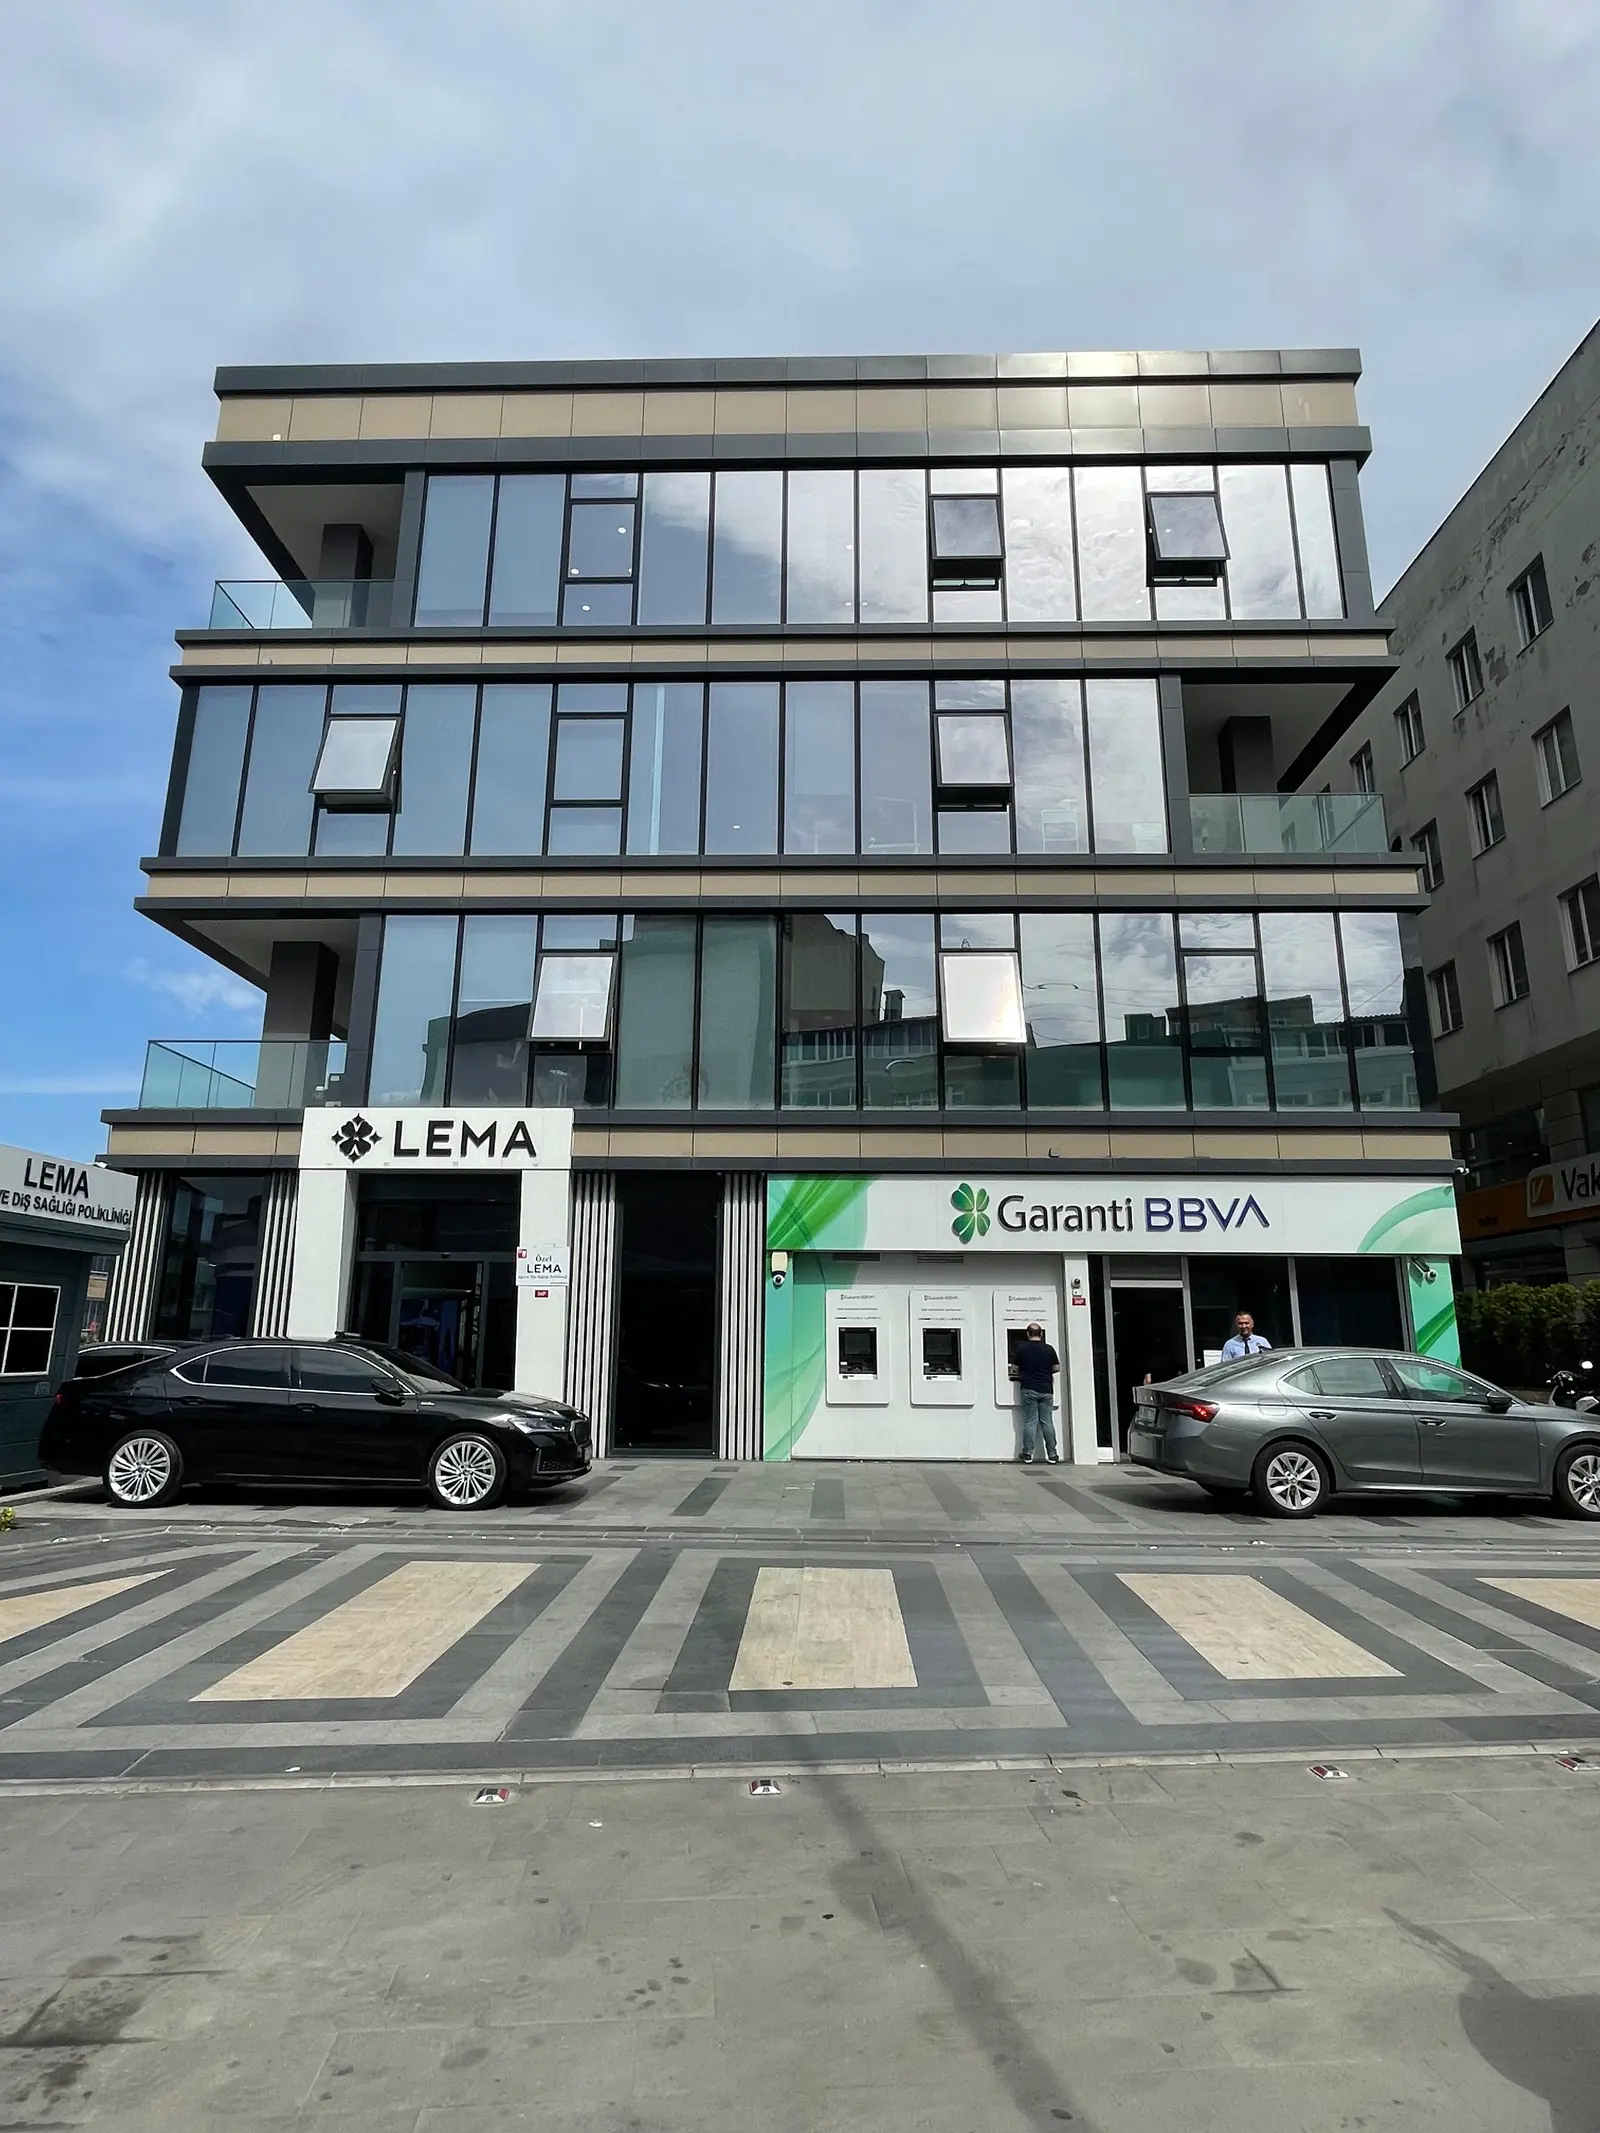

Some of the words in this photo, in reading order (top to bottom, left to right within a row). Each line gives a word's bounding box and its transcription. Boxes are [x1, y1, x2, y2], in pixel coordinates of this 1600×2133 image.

[393, 1120, 538, 1158] LEMA
[23, 1157, 89, 1199] LEMA
[33, 1195, 77, 1217] SAĞLIĞI
[997, 1194, 1134, 1233] Garanti
[1144, 1193, 1271, 1233] BBVA
[526, 1263, 562, 1274] LEMA
